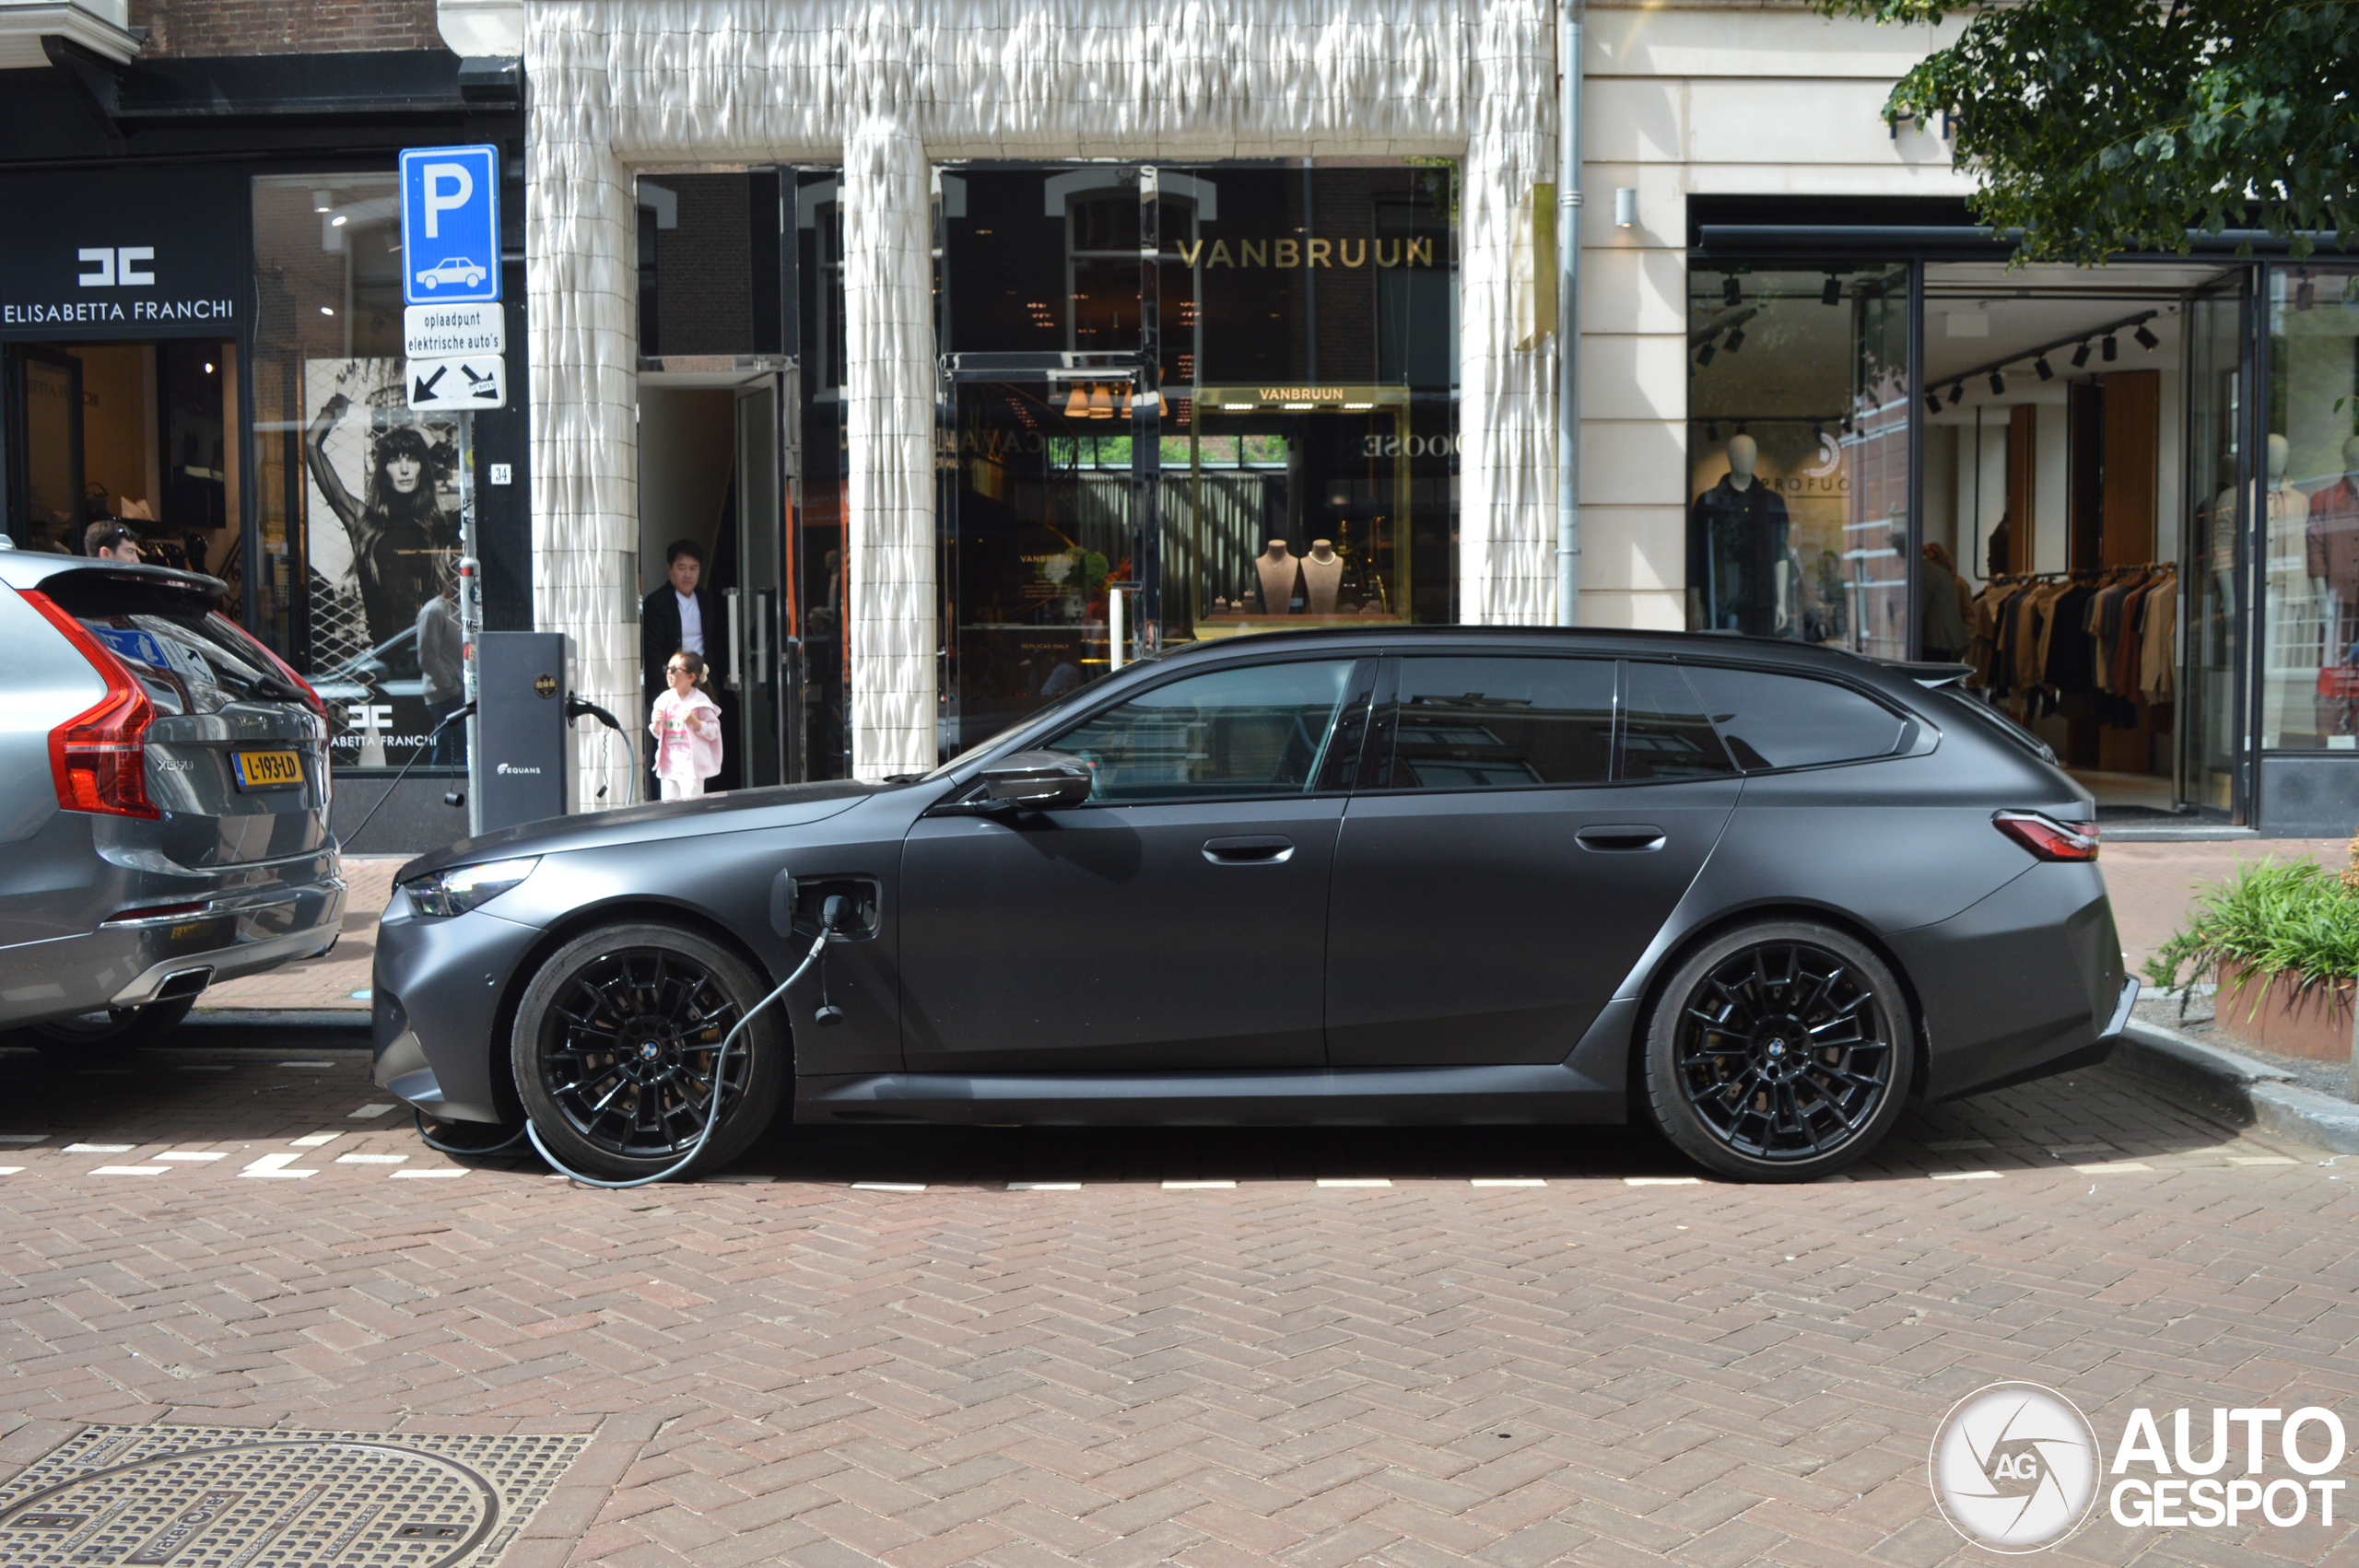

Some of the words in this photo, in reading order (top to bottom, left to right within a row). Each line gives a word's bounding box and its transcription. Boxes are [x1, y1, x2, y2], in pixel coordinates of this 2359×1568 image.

[424, 162, 474, 239] P
[1176, 237, 1433, 269] VANBRUUN
[5, 302, 125, 323] ELISABETTA
[134, 299, 234, 320] FRANCHI
[424, 310, 481, 330] oplaadpunt
[408, 334, 465, 351] elektrische
[467, 333, 499, 348] auto's
[1259, 388, 1344, 401] VANBRUUN
[495, 466, 508, 482] 34
[247, 755, 297, 780] L-193-LD
